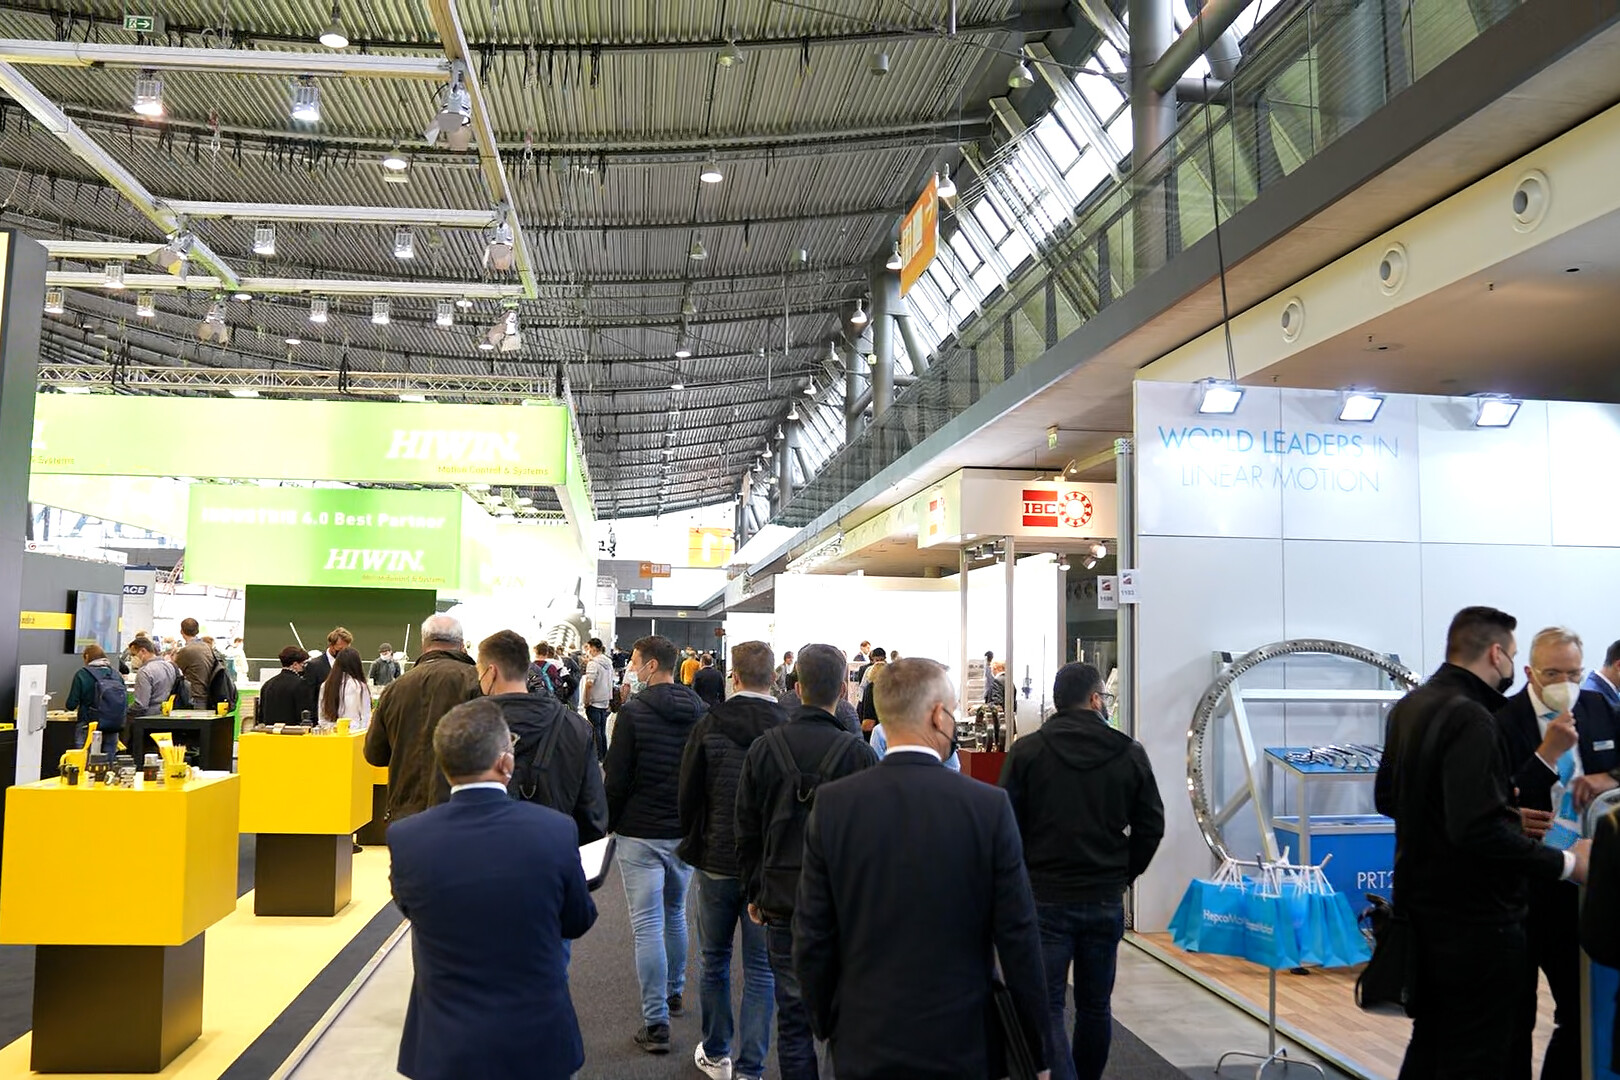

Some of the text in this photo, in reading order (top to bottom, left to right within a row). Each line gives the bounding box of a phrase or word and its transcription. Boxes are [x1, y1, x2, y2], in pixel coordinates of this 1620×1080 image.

[385, 429, 521, 461] HIWIN
[1157, 425, 1398, 459] WORLD LEADERS IN
[438, 465, 550, 477] Motion Control & Systems
[1181, 465, 1380, 492] LINEAR MOTION
[1024, 502, 1056, 515] IBC
[301, 511, 329, 525] 4.0
[335, 512, 372, 527] Best
[378, 513, 446, 530] Partner
[325, 549, 425, 572] HIWIN
[123, 585, 146, 595] ACE
